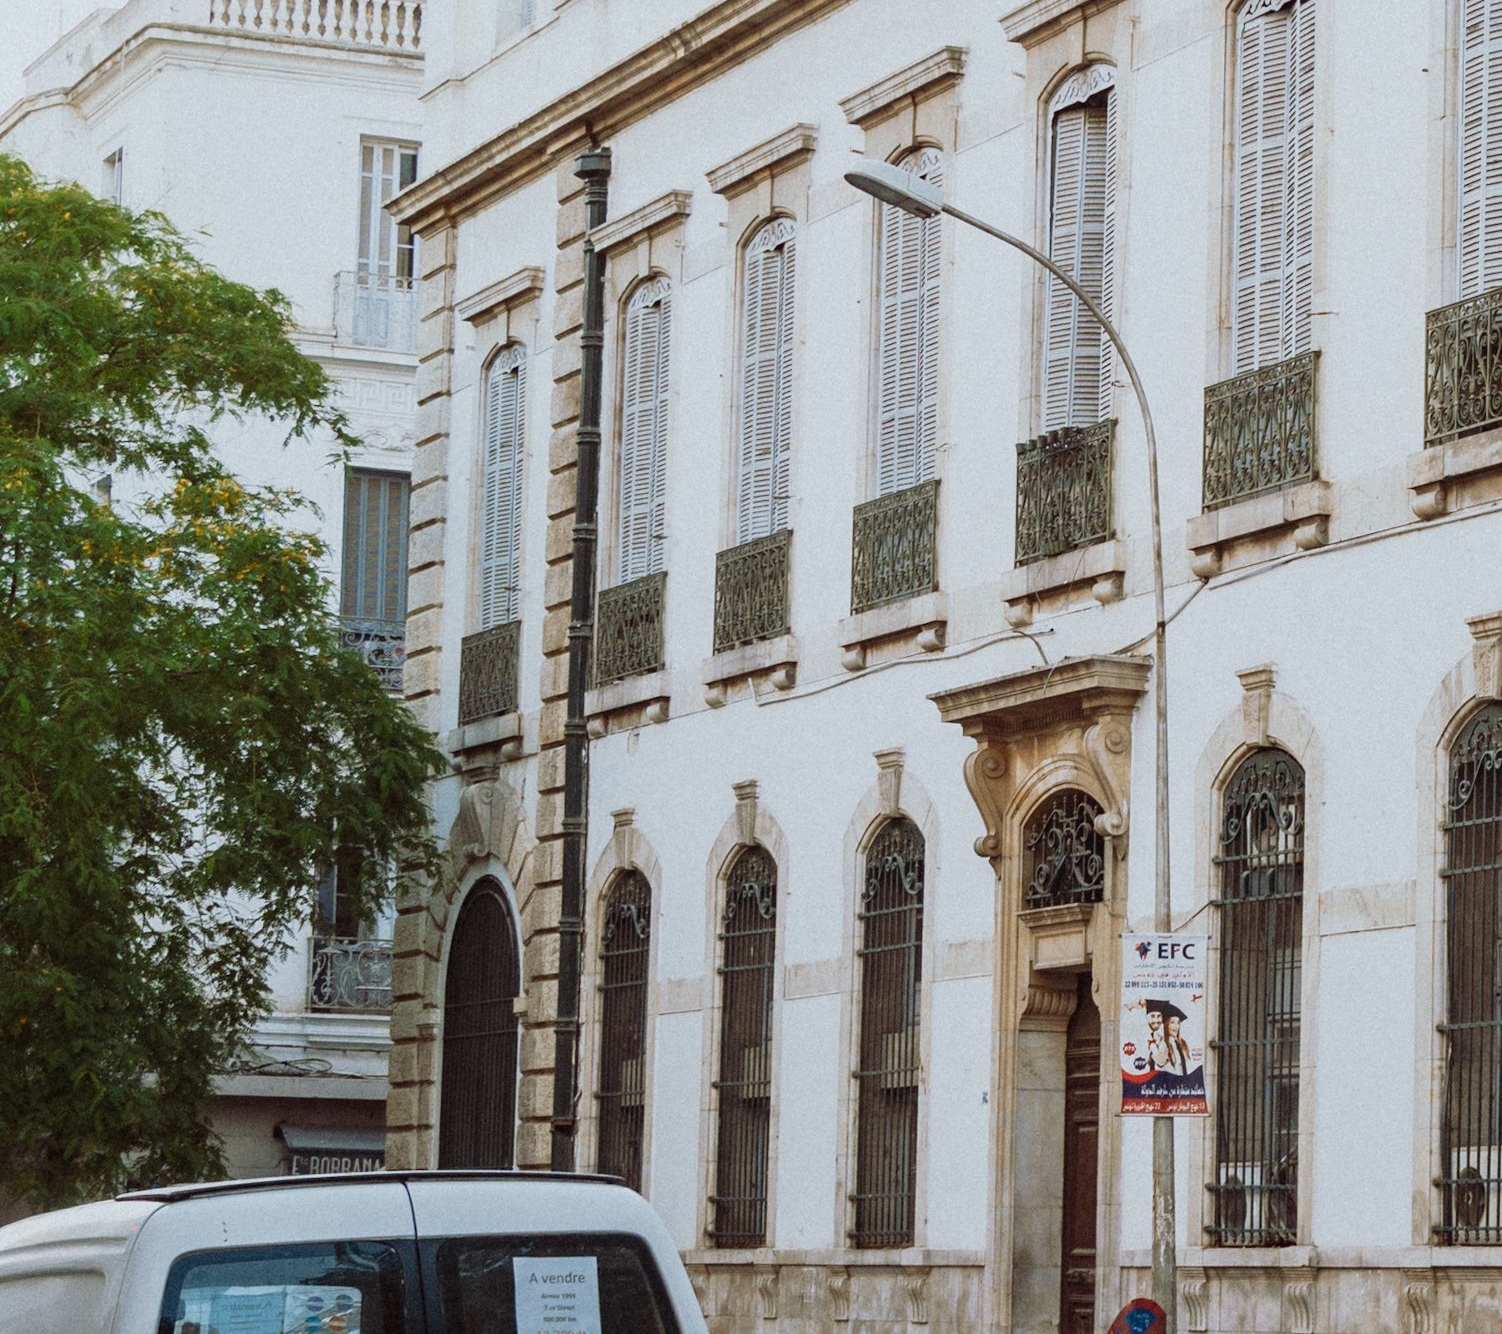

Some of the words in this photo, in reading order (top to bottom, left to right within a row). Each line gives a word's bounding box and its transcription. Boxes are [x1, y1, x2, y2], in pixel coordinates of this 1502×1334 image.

[1158, 943, 1195, 959] EFC
[529, 1273, 538, 1284] A
[541, 1271, 586, 1284] vendre
